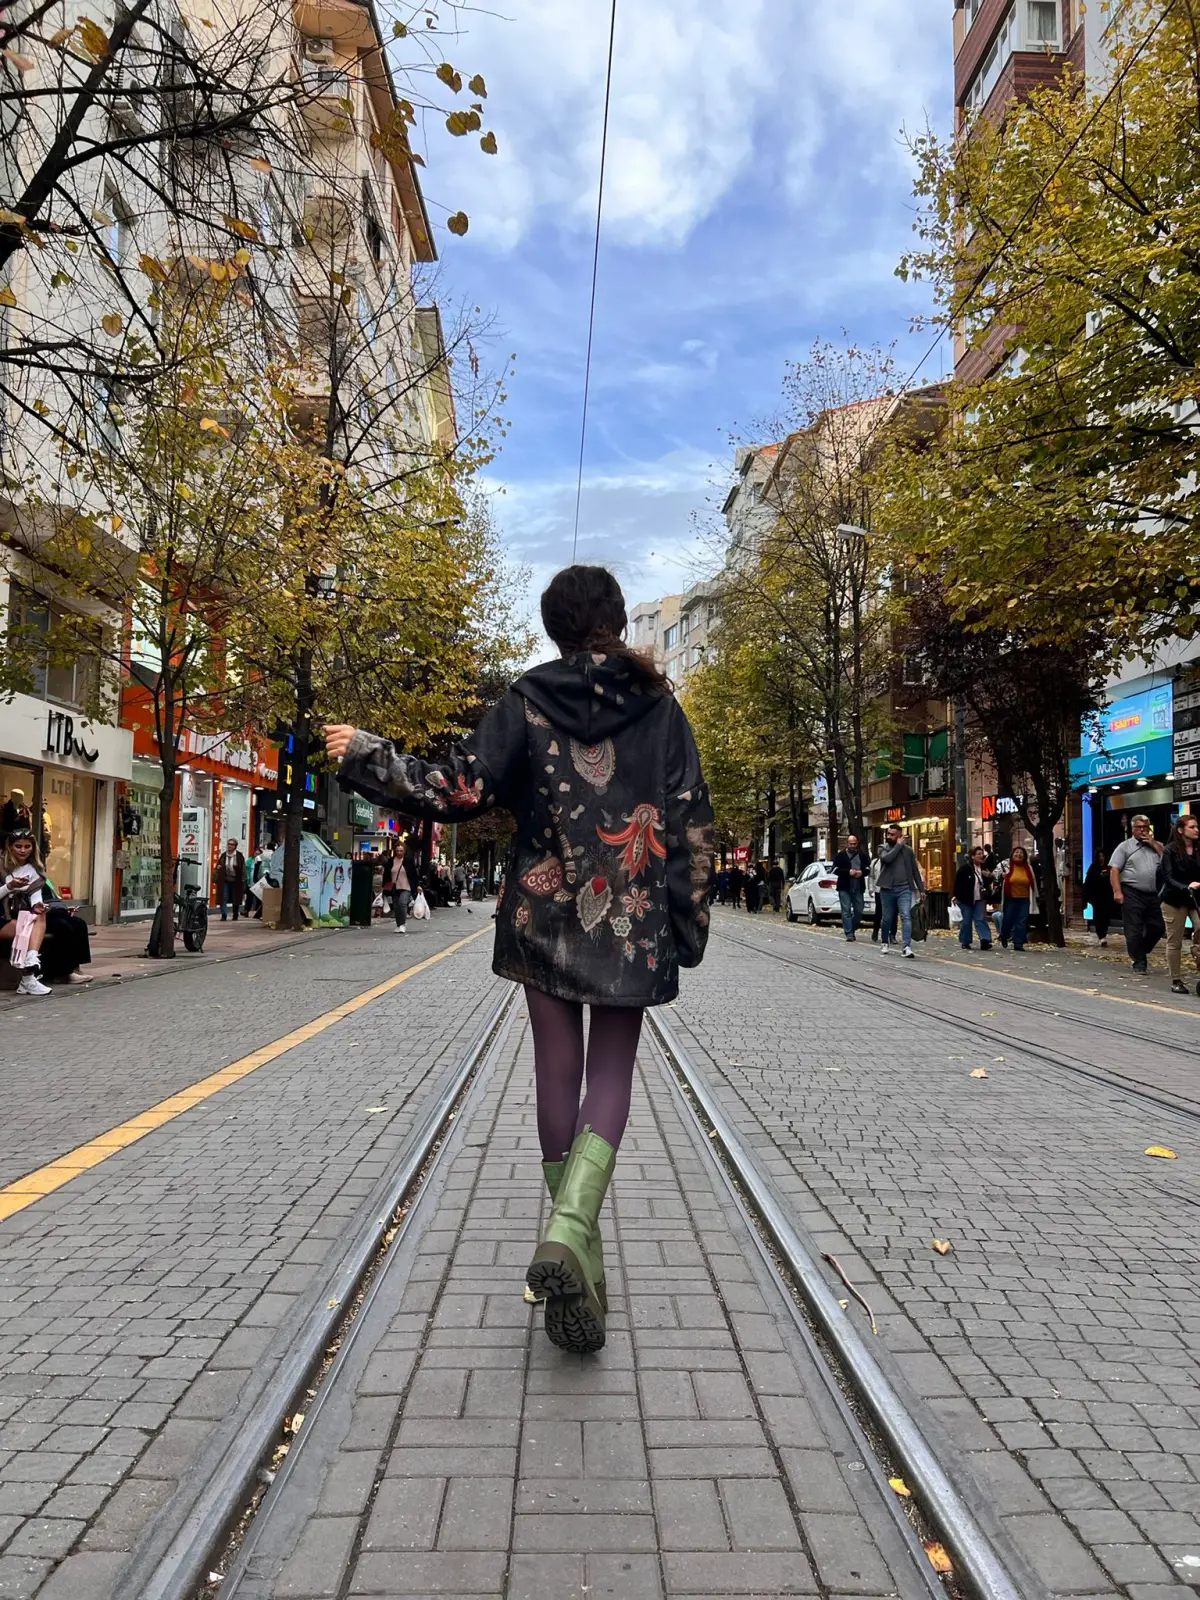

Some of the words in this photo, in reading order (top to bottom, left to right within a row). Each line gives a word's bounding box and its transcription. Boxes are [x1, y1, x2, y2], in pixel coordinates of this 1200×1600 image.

[47, 709, 73, 756] LTB
[1096, 755, 1138, 775] watsons
[982, 795, 996, 820] IN
[185, 833, 196, 846] 2
